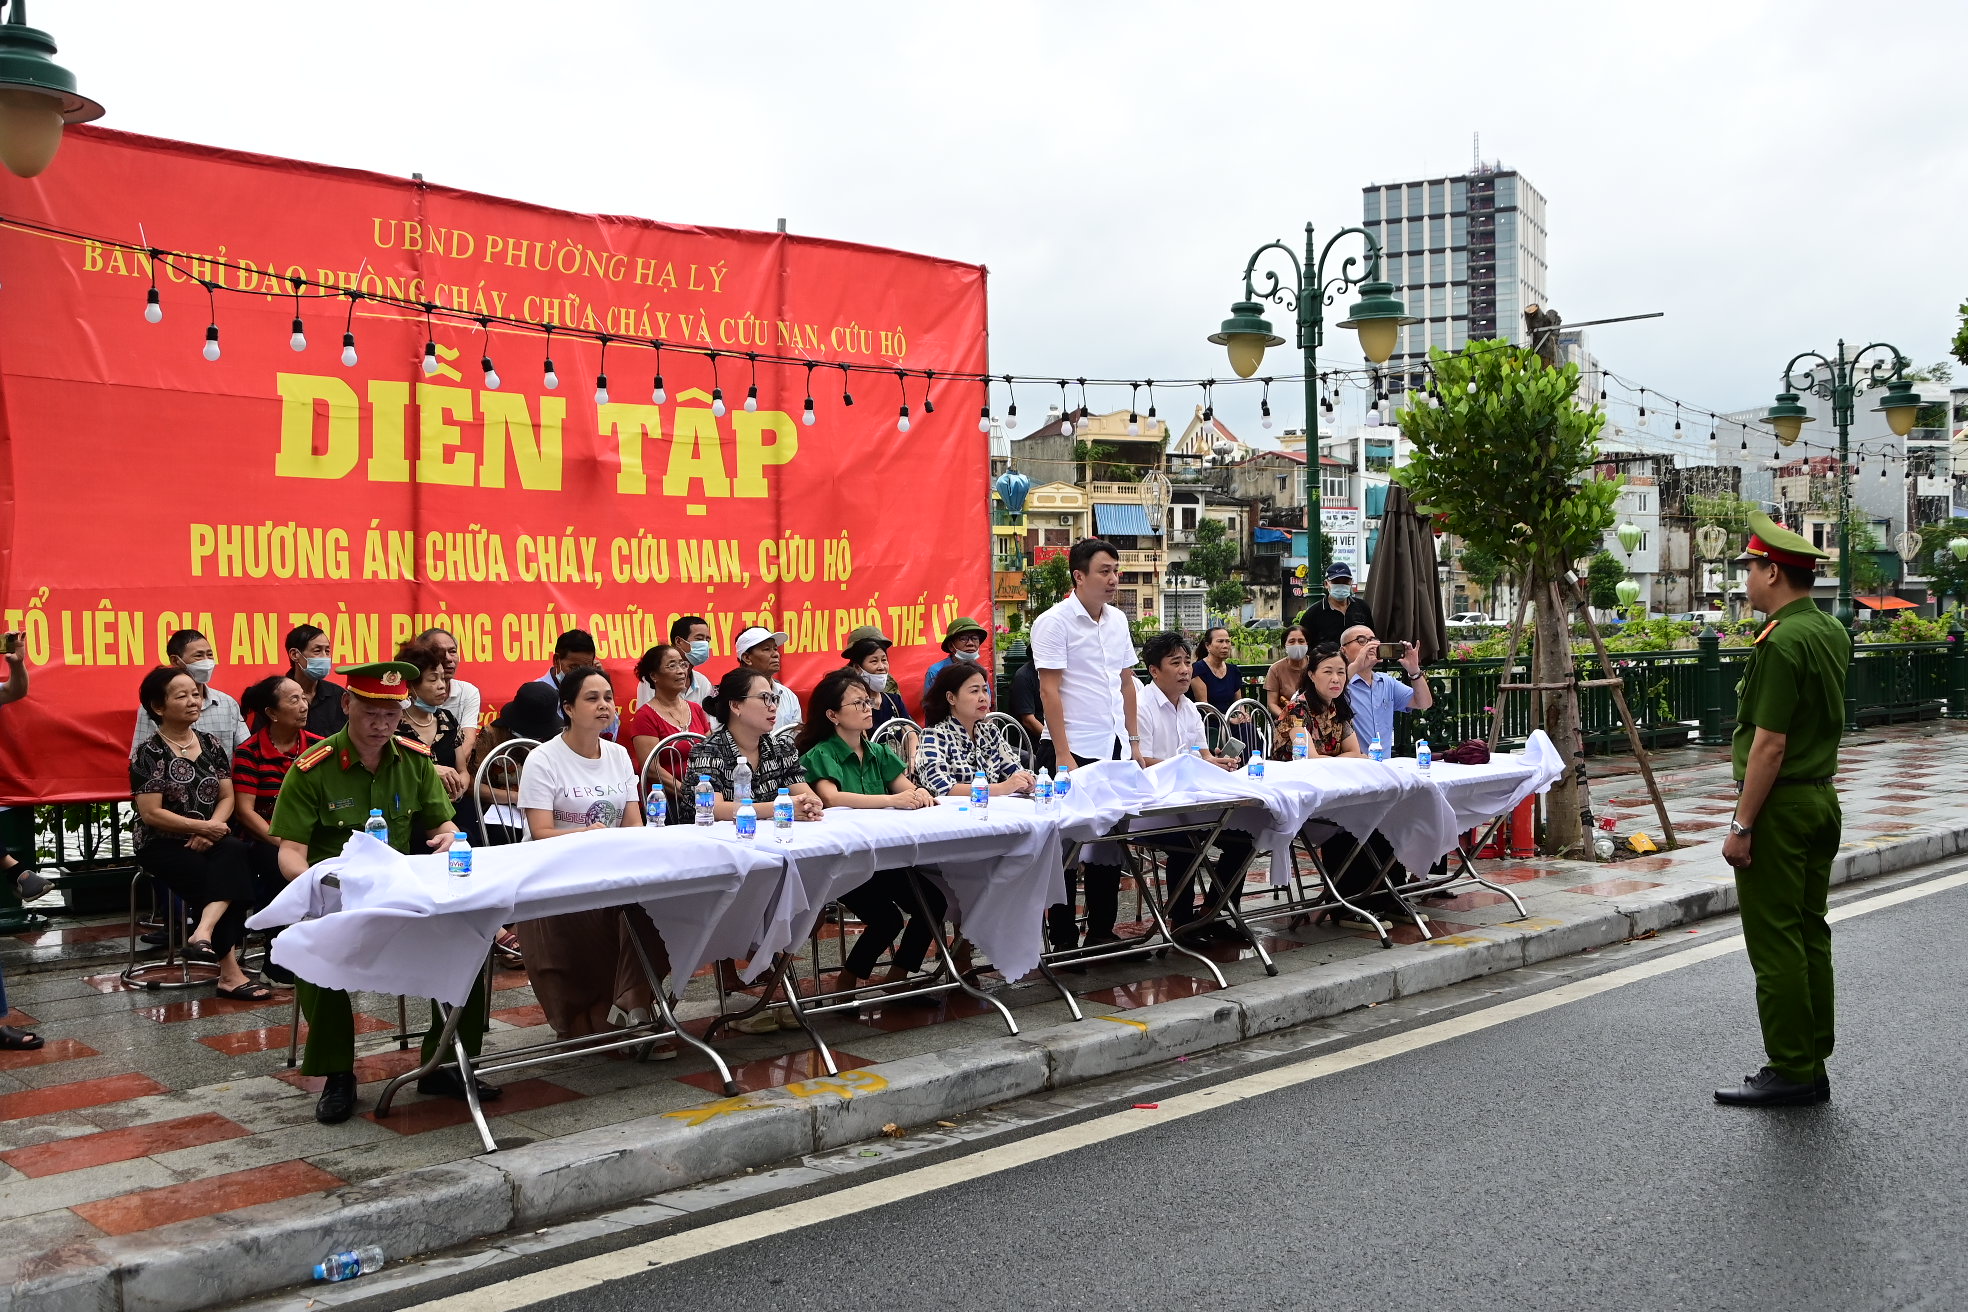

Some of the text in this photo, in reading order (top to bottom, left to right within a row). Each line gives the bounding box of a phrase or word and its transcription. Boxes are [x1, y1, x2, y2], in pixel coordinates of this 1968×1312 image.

[373, 217, 729, 293] UBND PHƯỜNG HẠ LÝ
[82, 239, 154, 280] BAN
[165, 245, 228, 289] CHỈ
[236, 258, 308, 302] ĐẠO
[317, 264, 426, 305] PHÒNG
[523, 293, 597, 331] CHỮA
[606, 302, 671, 339] CHÁY
[678, 307, 712, 342] VÀ
[719, 311, 768, 346] CỨU
[776, 320, 826, 355] NẠN,
[831, 320, 873, 353] CỨU
[879, 325, 907, 364] HỘ
[275, 343, 798, 515] DIỄN TẬP
[190, 518, 852, 593] PHƯƠNG ÁN CHỮA CHÁY, CỨU NẠN, CỨU HỘ
[62, 598, 145, 666] LIÊN
[230, 612, 279, 665] AN
[589, 604, 659, 660] CHỮA
[666, 602, 734, 657] ÁY
[783, 600, 830, 654] DÂN
[888, 591, 928, 648] THẾ
